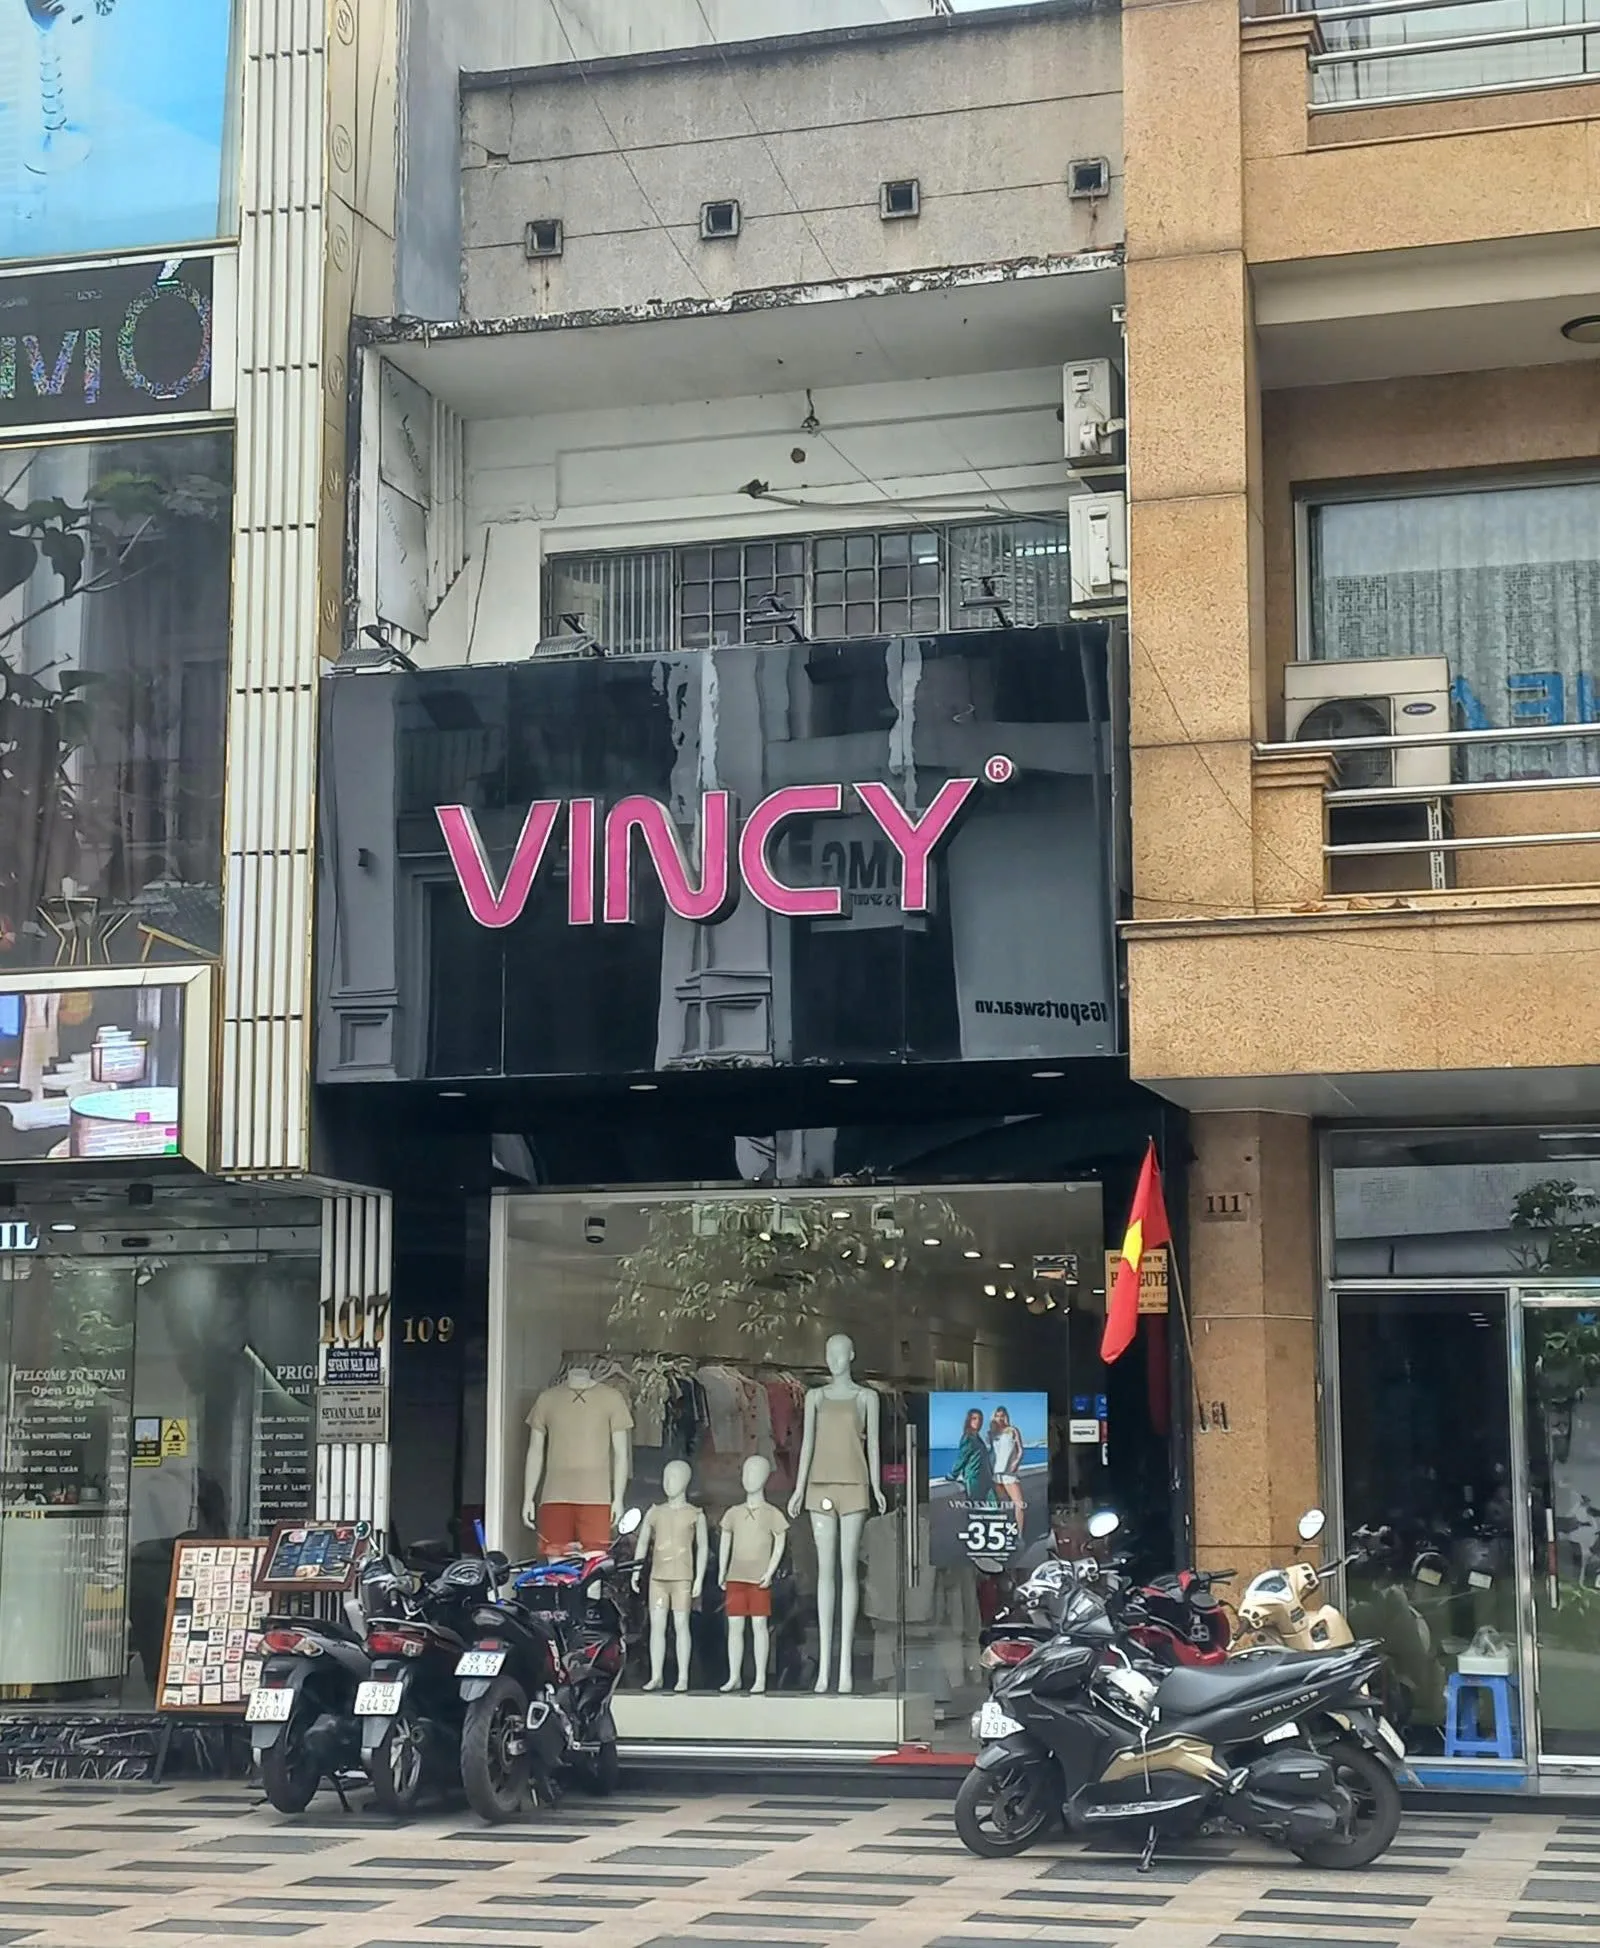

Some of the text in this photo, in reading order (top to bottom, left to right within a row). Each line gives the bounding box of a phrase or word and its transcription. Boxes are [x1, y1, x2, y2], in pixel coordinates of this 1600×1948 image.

[434, 777, 979, 929] VINCY
[1206, 1195, 1241, 1213] 111
[319, 1291, 388, 1343] 107
[403, 1316, 455, 1343] 109
[31, 1385, 61, 1398] Open
[958, 1521, 1018, 1550] -35%
